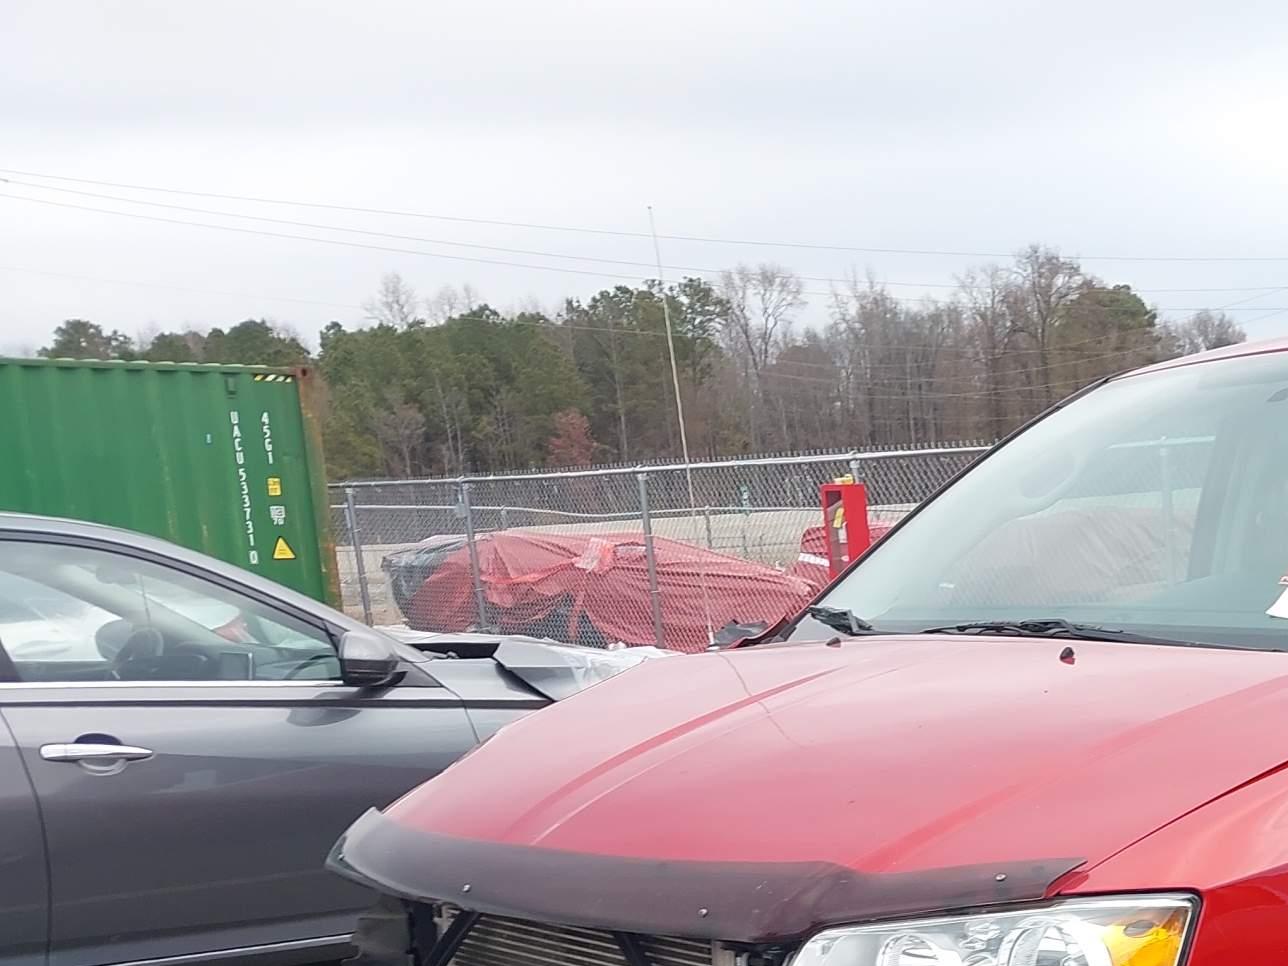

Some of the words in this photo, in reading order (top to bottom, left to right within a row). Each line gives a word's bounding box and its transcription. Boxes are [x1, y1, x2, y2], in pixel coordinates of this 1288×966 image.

[230, 411, 245, 464] UACU
[238, 468, 254, 546] 533731
[261, 412, 273, 464] 45G1
